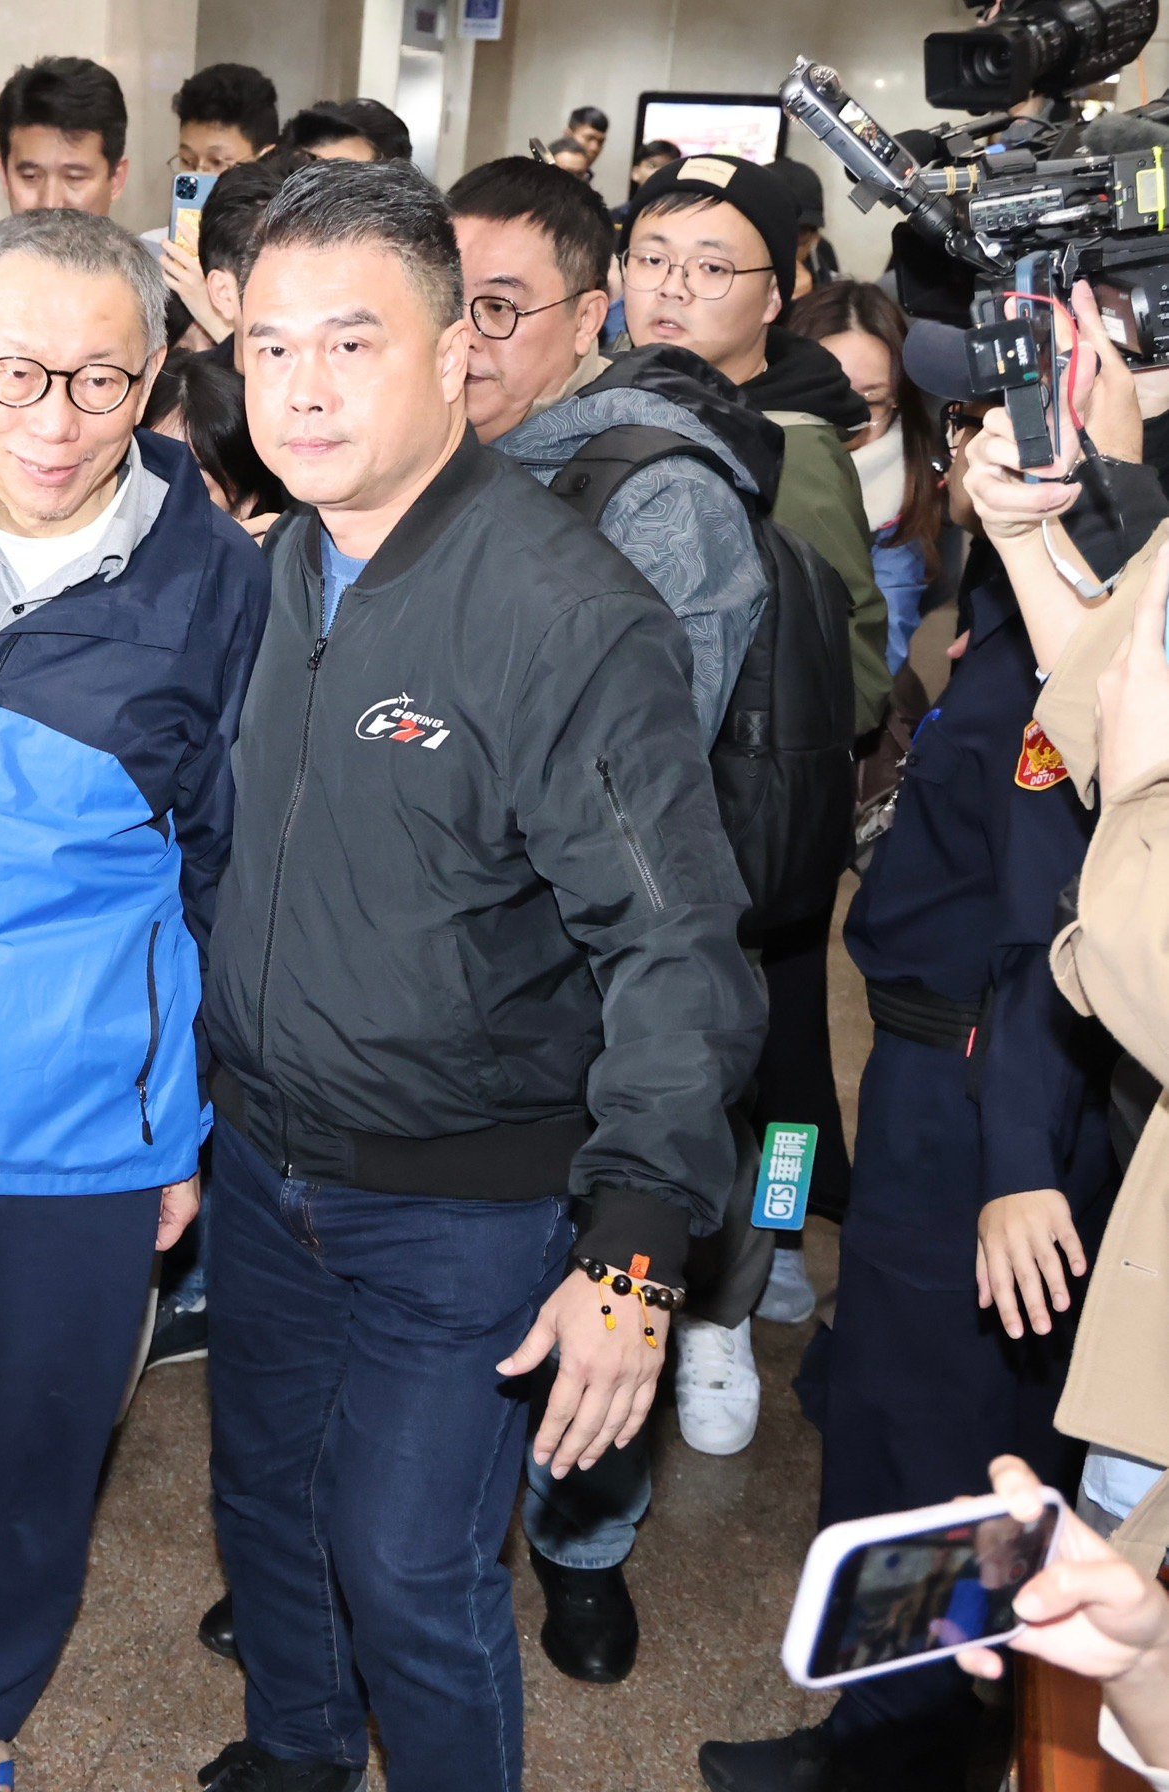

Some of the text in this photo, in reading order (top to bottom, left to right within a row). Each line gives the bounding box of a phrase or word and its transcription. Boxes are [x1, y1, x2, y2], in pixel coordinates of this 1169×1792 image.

[390, 708, 444, 729] BOEING
[1030, 772, 1056, 785] 0070
[767, 1131, 808, 1217] CTS 華視
